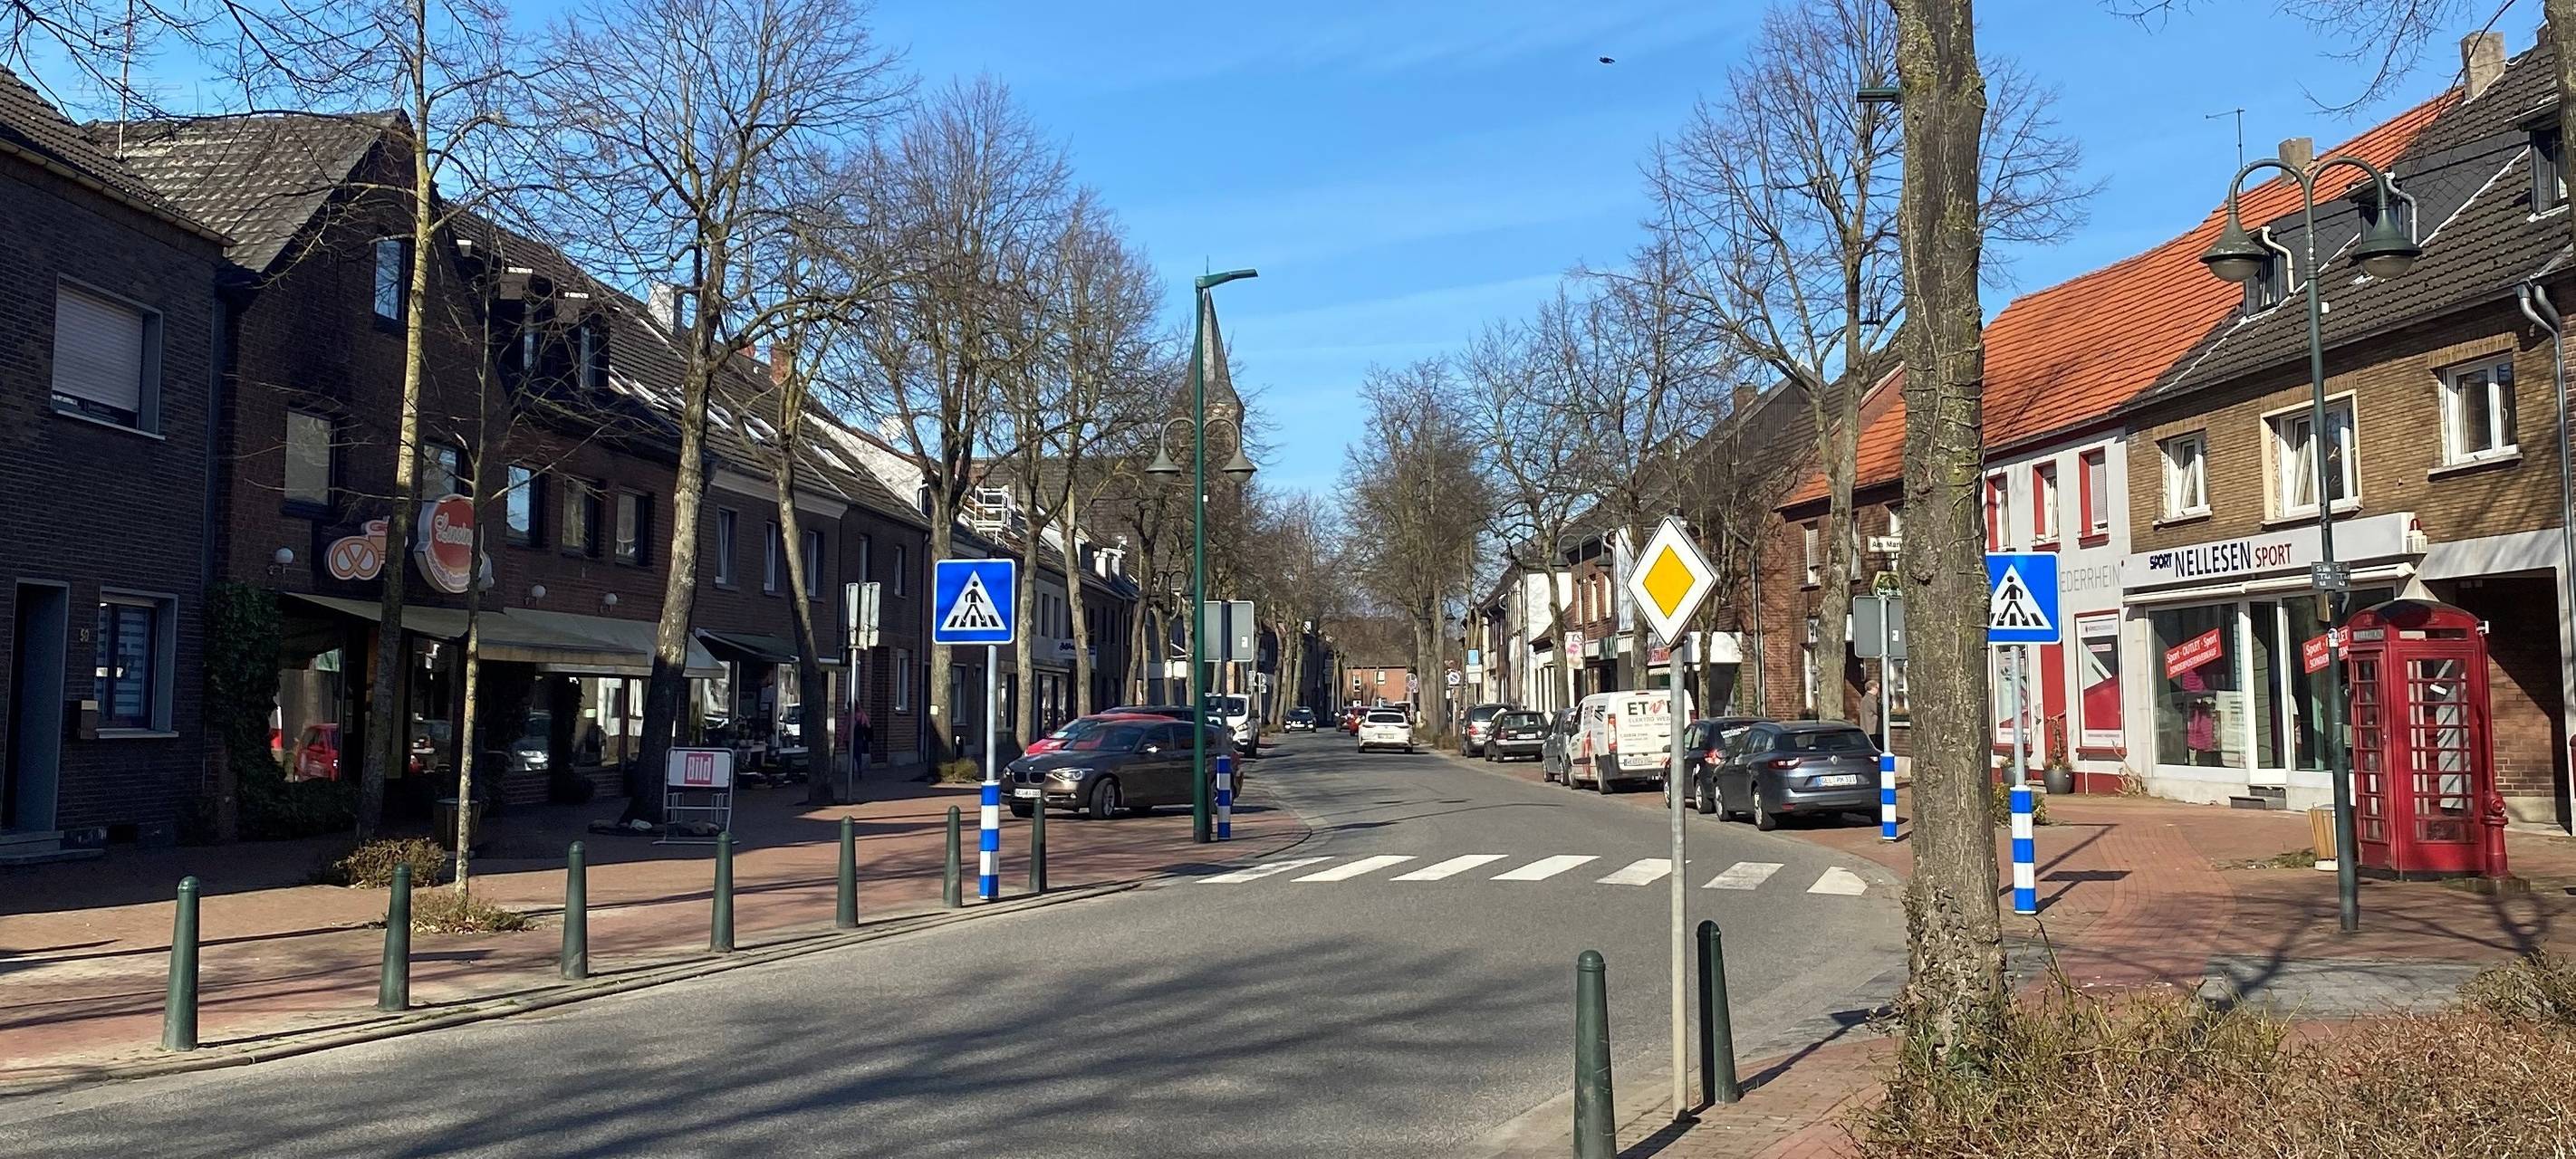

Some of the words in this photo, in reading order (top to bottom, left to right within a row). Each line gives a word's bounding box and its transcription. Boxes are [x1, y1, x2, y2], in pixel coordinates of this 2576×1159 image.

[435, 512, 474, 548] Lensin
[2149, 552, 2172, 570] SPORT
[2175, 541, 2252, 578] NELLESEN
[2254, 543, 2292, 568] SPORT
[2061, 564, 2120, 593] EDERRHEIN
[2167, 650, 2180, 664] Sport
[2182, 639, 2201, 657] OUTLET
[2203, 634, 2217, 648] Sport
[2305, 640, 2322, 656] Sport
[687, 756, 712, 781] Bild
